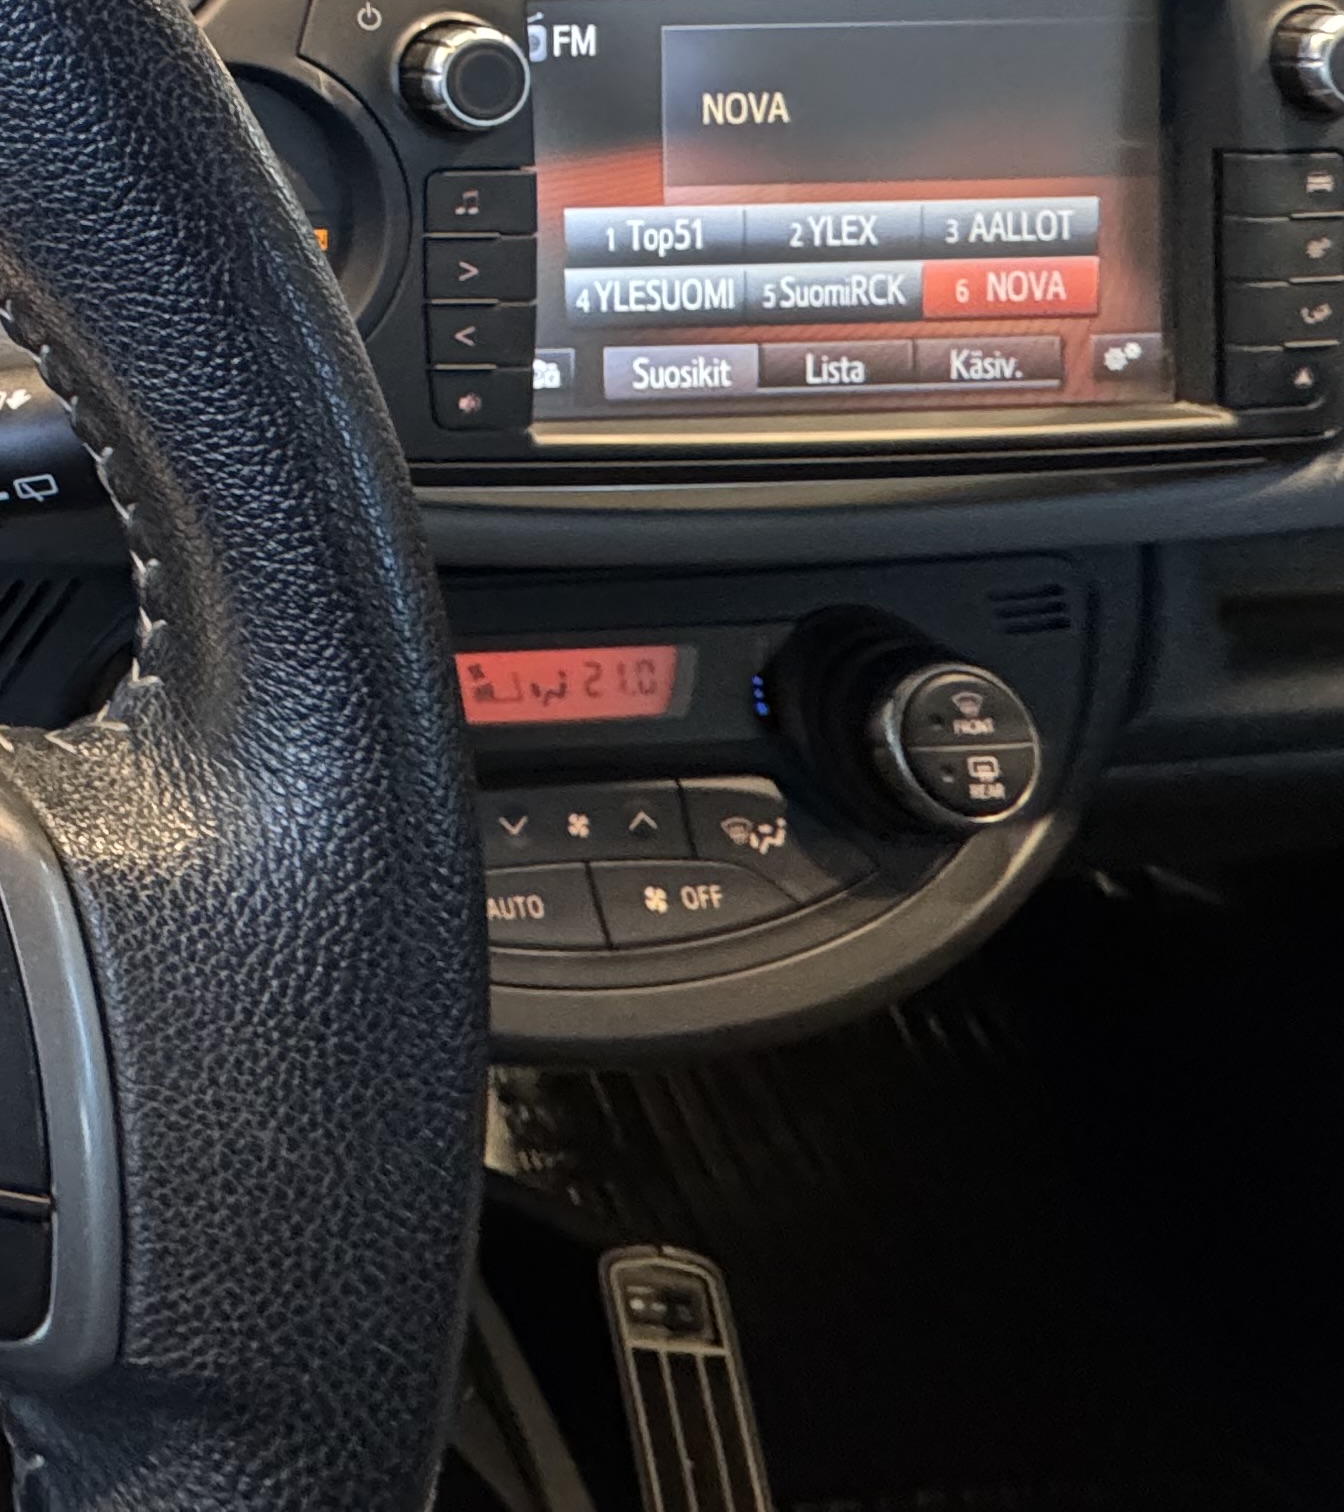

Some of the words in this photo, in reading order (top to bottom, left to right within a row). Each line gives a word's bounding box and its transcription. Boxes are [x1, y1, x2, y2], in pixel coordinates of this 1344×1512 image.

[552, 24, 597, 58] FM
[701, 91, 792, 126] NOVA
[606, 227, 616, 252] 1
[627, 218, 705, 258] Top51
[788, 222, 804, 248] 2
[806, 214, 879, 248] YLEX
[944, 219, 960, 244] 3
[968, 208, 1077, 244] AALLOT
[575, 289, 591, 314] 4
[594, 278, 736, 313] YLESUOMI
[762, 284, 777, 309] 5
[779, 273, 908, 309] SuomiRCK
[955, 278, 970, 304] 6
[986, 269, 1067, 303] NOVA
[632, 355, 733, 390] Suosikit
[804, 352, 867, 386] Lista
[949, 348, 1025, 381] Käsiv.
[679, 884, 723, 911] OFF
